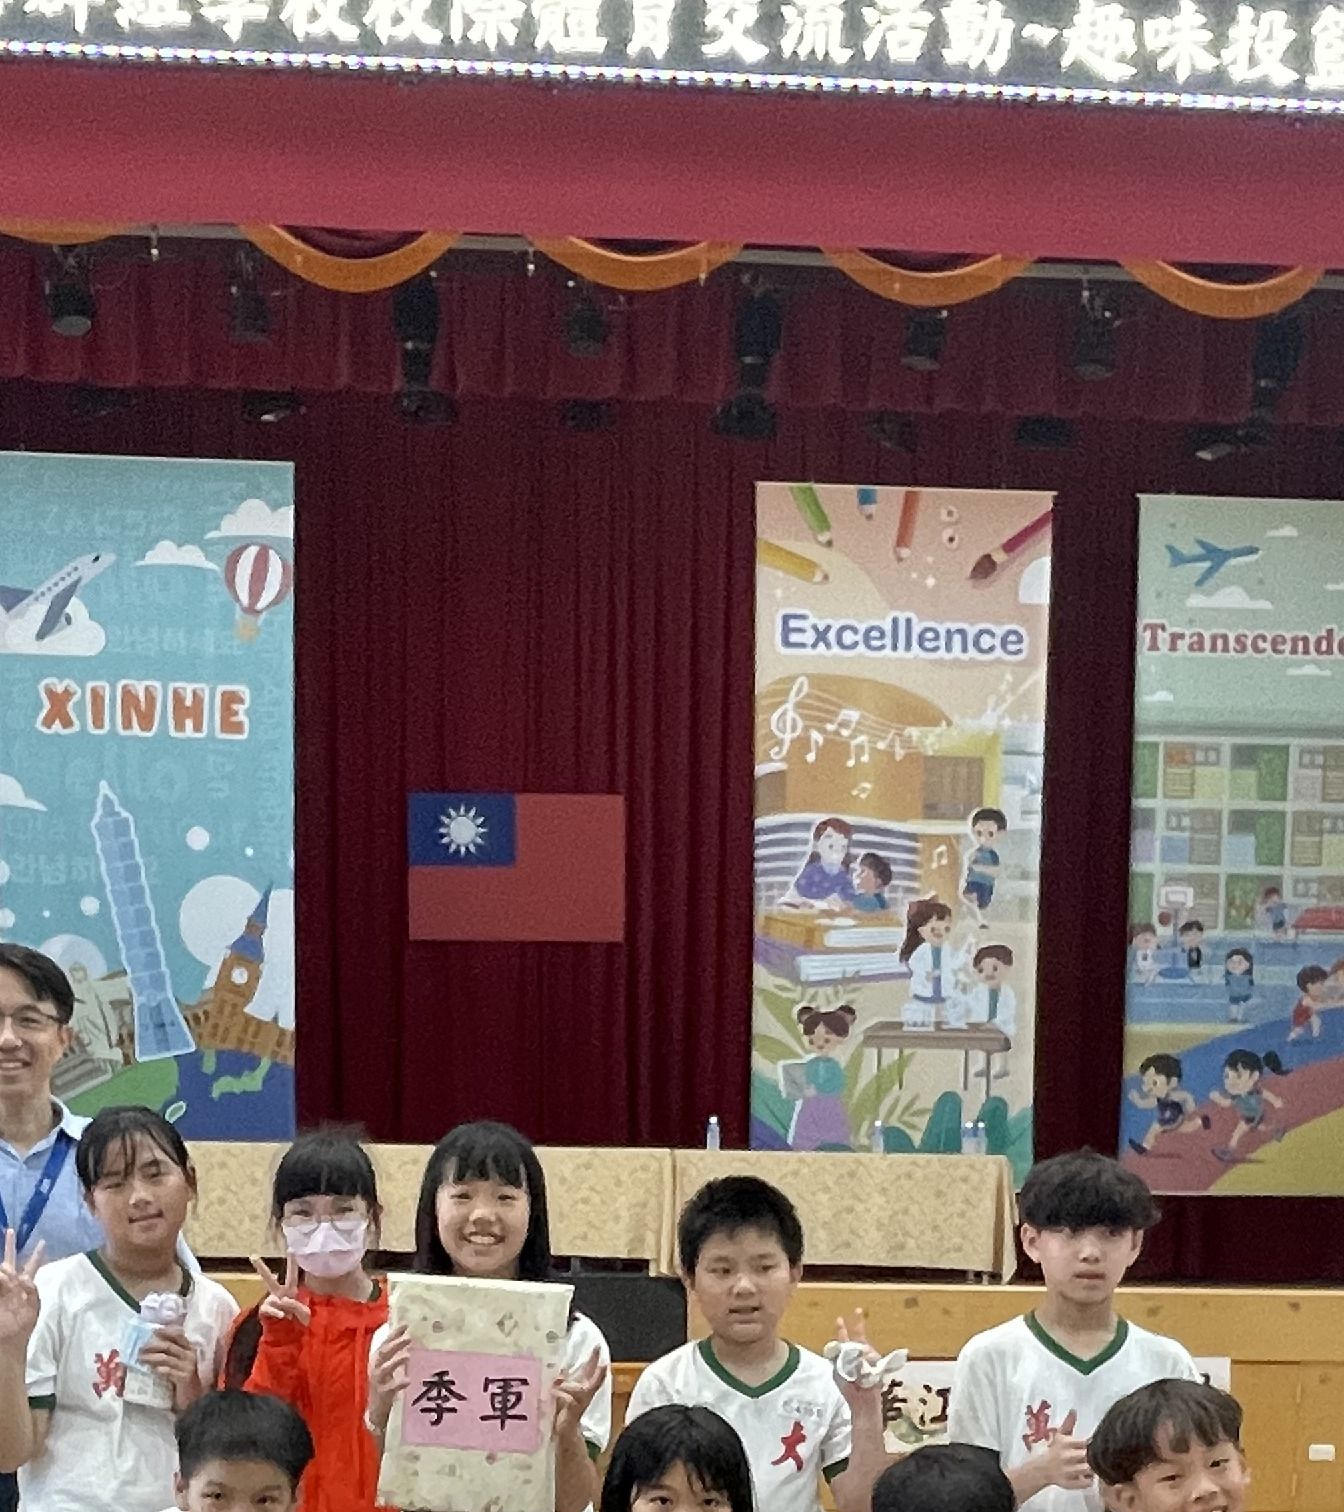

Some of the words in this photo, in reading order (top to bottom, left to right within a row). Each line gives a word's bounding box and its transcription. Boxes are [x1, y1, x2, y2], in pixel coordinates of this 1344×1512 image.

[778, 611, 1026, 657] Excellence
[37, 679, 249, 738] XINHE
[411, 1369, 530, 1432] 季軍
[771, 1420, 807, 1472] 大
